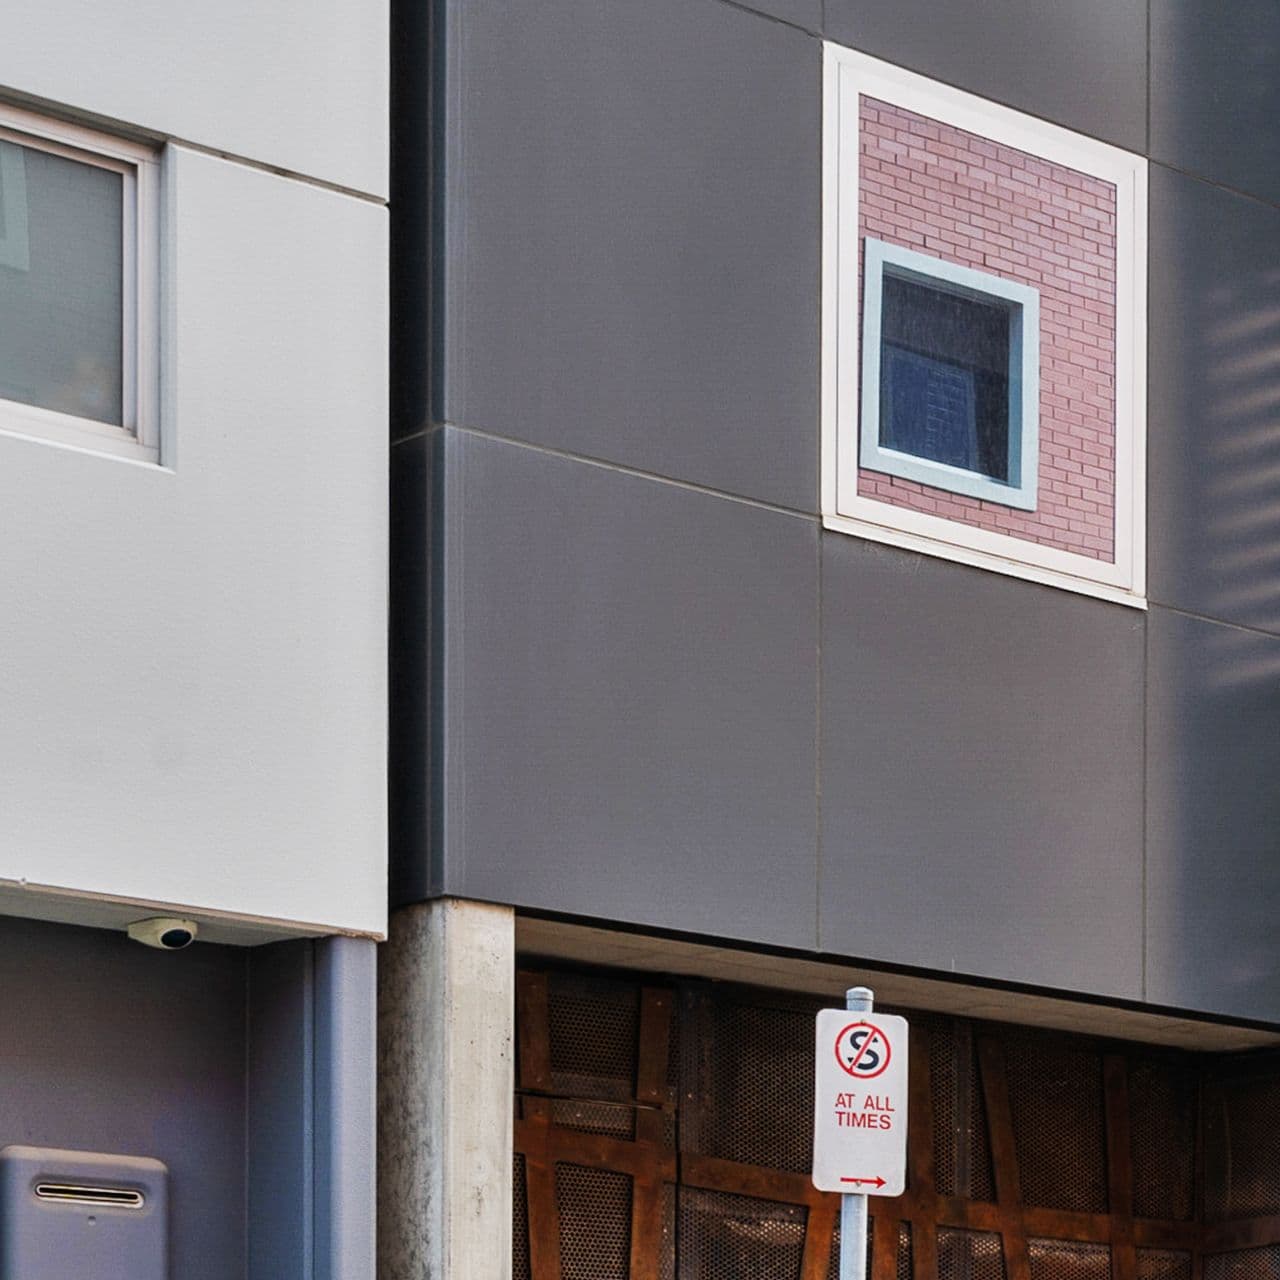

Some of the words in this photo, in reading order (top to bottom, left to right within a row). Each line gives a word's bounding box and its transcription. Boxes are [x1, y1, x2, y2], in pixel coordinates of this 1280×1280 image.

[835, 1093, 856, 1108] AT
[864, 1095, 895, 1112] ALL
[835, 1111, 892, 1130] TIMES
